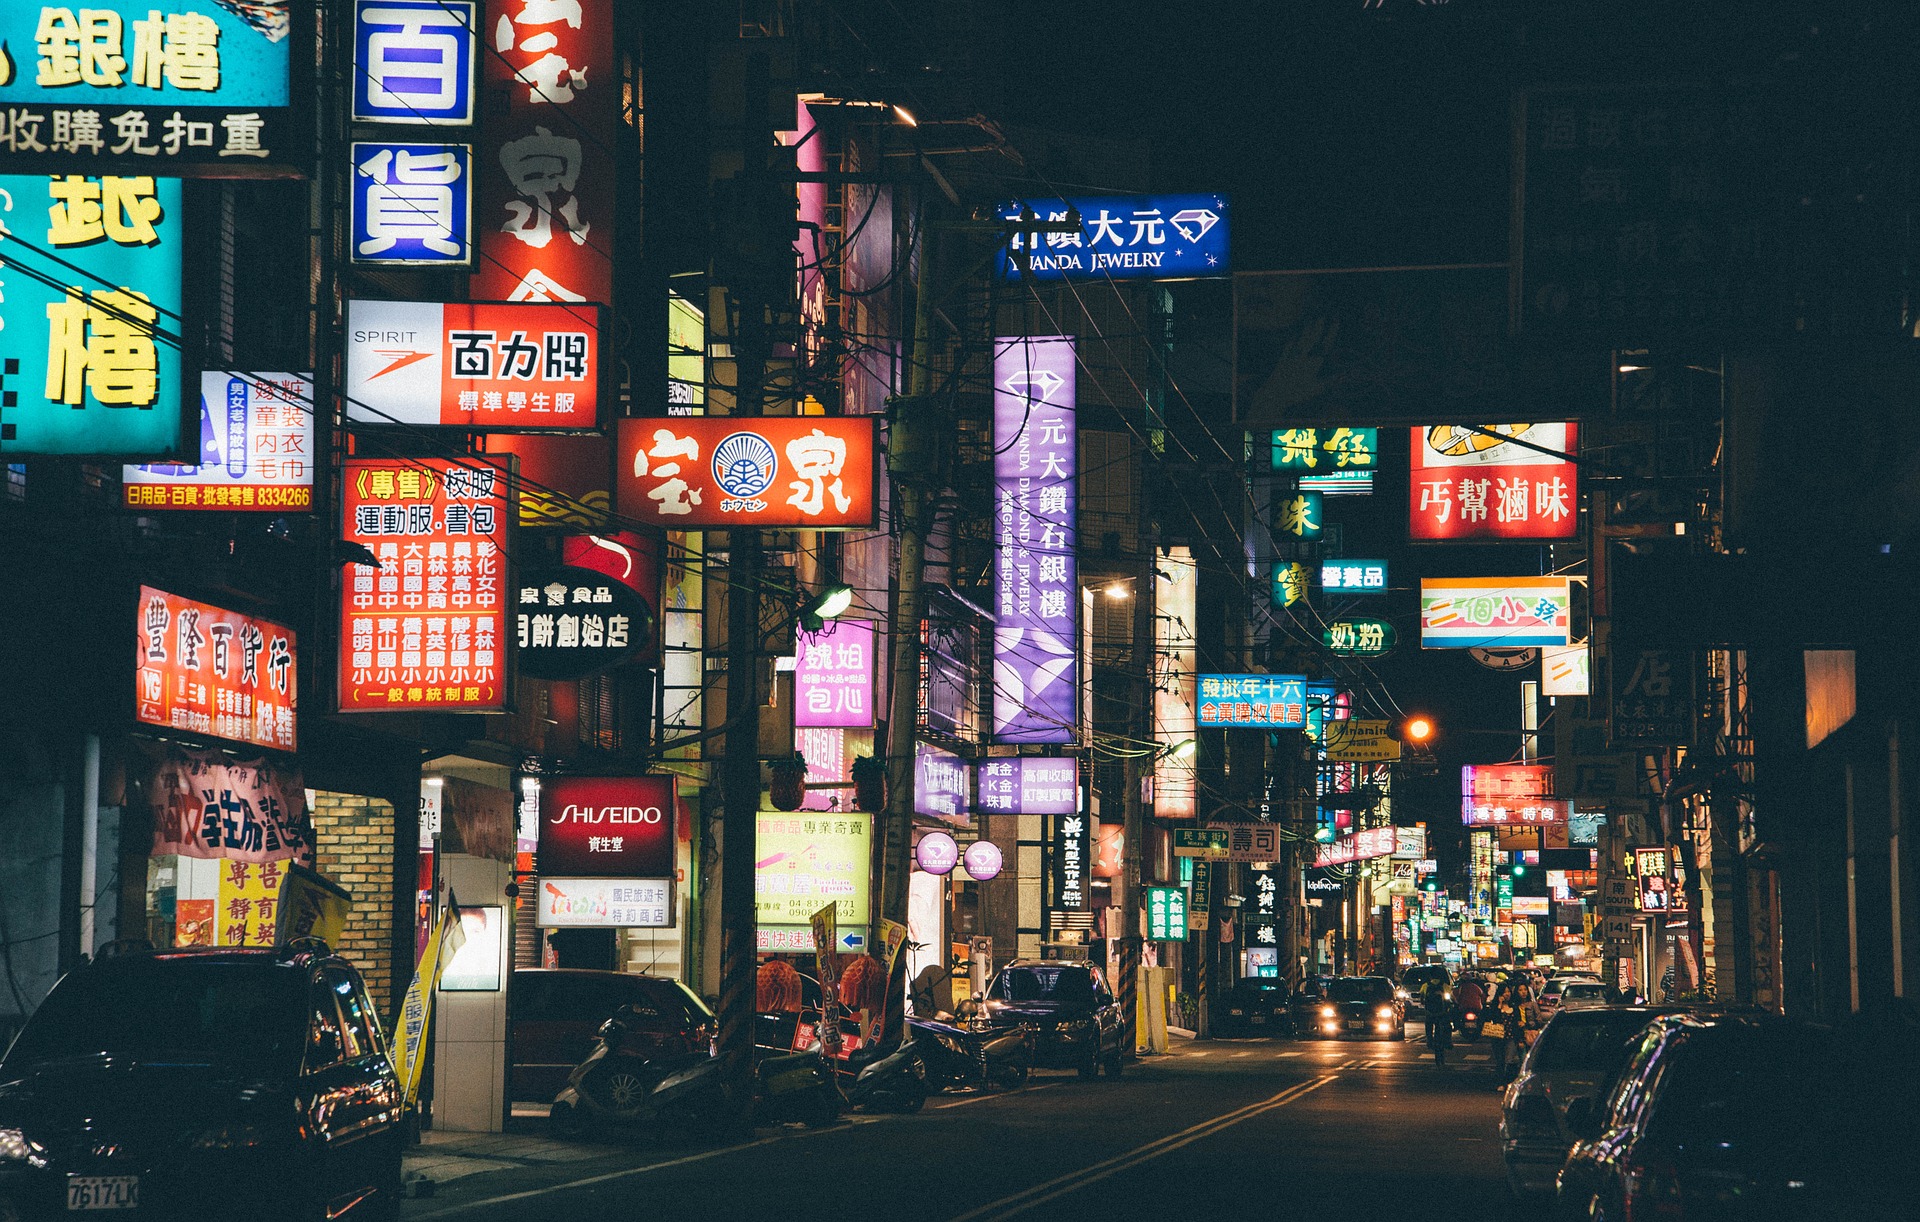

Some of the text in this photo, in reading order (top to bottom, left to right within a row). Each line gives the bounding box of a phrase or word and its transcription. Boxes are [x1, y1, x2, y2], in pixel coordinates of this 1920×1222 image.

[0, 7, 223, 91] 銀樓
[0, 108, 270, 158] 收購免扣重
[358, 8, 466, 256] 百貨
[1090, 251, 1166, 273] JEWELRY
[354, 330, 418, 344] SPIRIT
[448, 329, 589, 382] 百力牌
[457, 390, 576, 414] 標準學生服
[255, 405, 305, 428] 童裝
[255, 458, 304, 480] 毛巾
[257, 486, 311, 506] 8334266
[443, 467, 496, 500] 校服
[720, 500, 769, 513] ホウセン
[1019, 477, 1030, 543] DIAMOND
[1039, 417, 1068, 618] 元大鑽石銀樓
[378, 541, 399, 610] 員林國中
[402, 541, 424, 610] 大同國中
[427, 541, 448, 610] 員林家商
[451, 541, 472, 610] 員林高中
[475, 541, 497, 610] 彰化女中
[1322, 566, 1384, 587] 營養品
[571, 586, 613, 605] 食品
[1016, 563, 1030, 617] JEWELRY
[376, 616, 398, 685] 東山國小
[400, 616, 423, 685] 僑信國小
[425, 616, 447, 685] 育英國小
[449, 616, 471, 685] 靜修國小
[473, 616, 495, 685] 員林國小
[1330, 622, 1385, 652] 奶粉
[804, 643, 864, 670] 魏姐
[804, 686, 863, 714] 包心
[986, 763, 1013, 777] 黃金
[1023, 769, 1074, 783] 高價收購
[988, 779, 1013, 793] K金
[550, 804, 662, 824] SHISEIDO
[986, 795, 1013, 809] 珠寶
[588, 836, 624, 853] 資生堂
[1183, 831, 1221, 841] 民族街
[1233, 827, 1275, 853] 壽司
[612, 888, 664, 903] 國民旅遊卡
[1195, 868, 1206, 904] 中正路
[1612, 882, 1626, 896] 南
[1255, 873, 1277, 944] 鈺珊樓
[1605, 896, 1633, 904] SOUTH
[612, 908, 664, 923] 特約商店
[1609, 922, 1629, 932] 141
